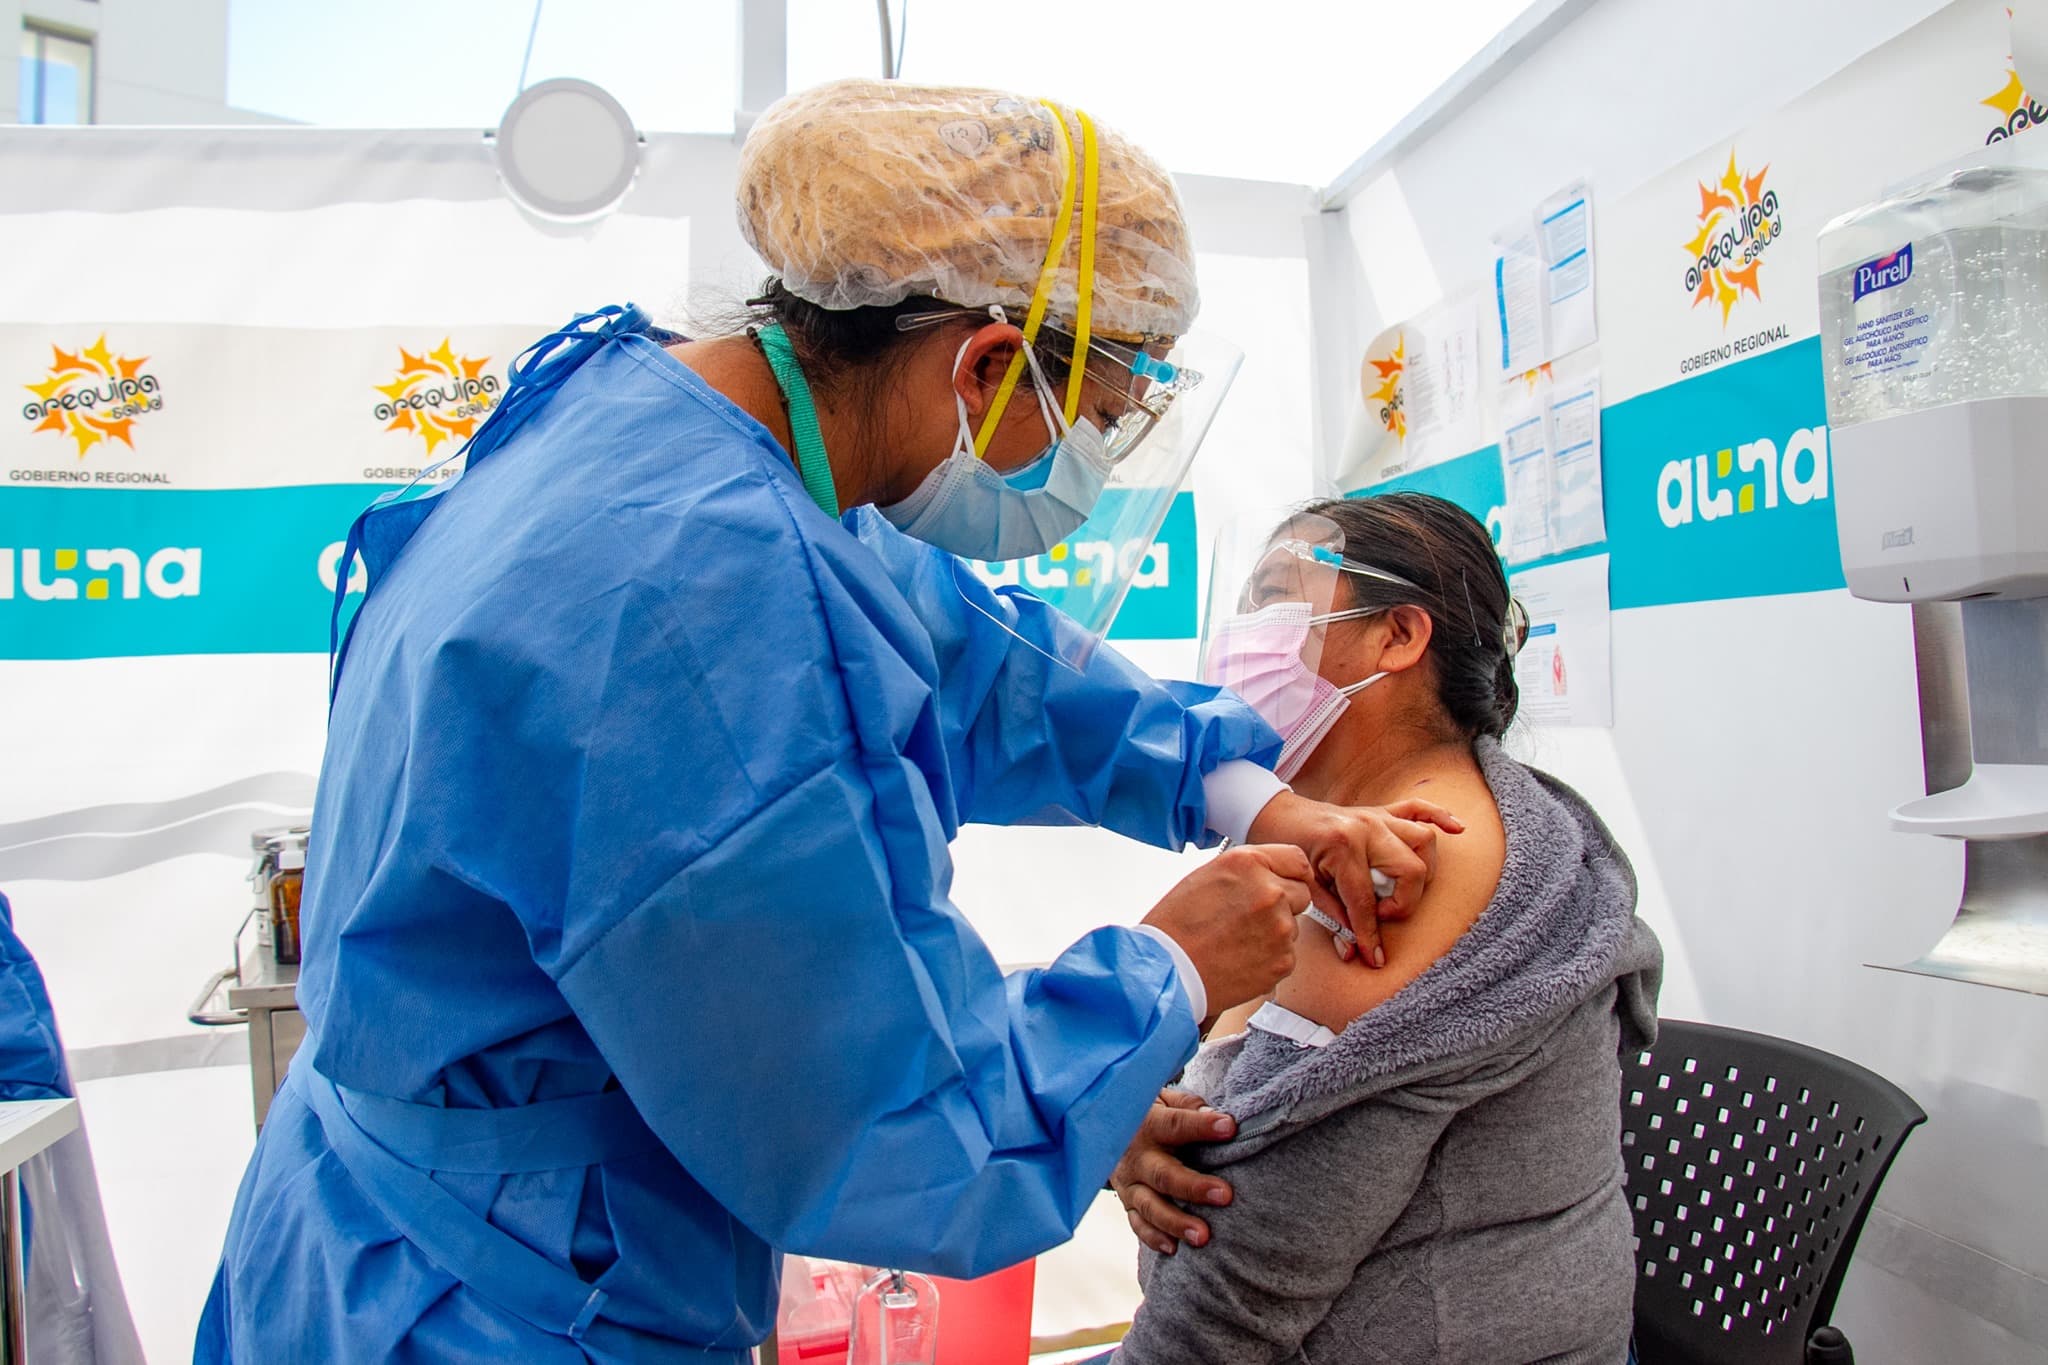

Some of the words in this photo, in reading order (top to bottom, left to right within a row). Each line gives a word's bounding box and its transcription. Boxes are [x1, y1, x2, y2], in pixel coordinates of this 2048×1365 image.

[1685, 190, 1779, 292] arequipa
[1743, 214, 1782, 264] salud
[1858, 254, 1908, 293] Purell
[1857, 320, 1874, 331] HAND
[1876, 311, 1903, 326] SANITIZER
[1883, 331, 1905, 342] MANOS
[1680, 344, 1731, 374] GOBIERNO
[1734, 324, 1790, 355] REGIONAL
[23, 374, 160, 420] arequipa
[112, 395, 163, 419] salud
[374, 375, 500, 420] arequipa
[9, 469, 90, 483] GOBIERNO
[95, 471, 171, 484] REGIONAL
[363, 468, 438, 479] GOBIERO
[1657, 425, 1828, 528] auna
